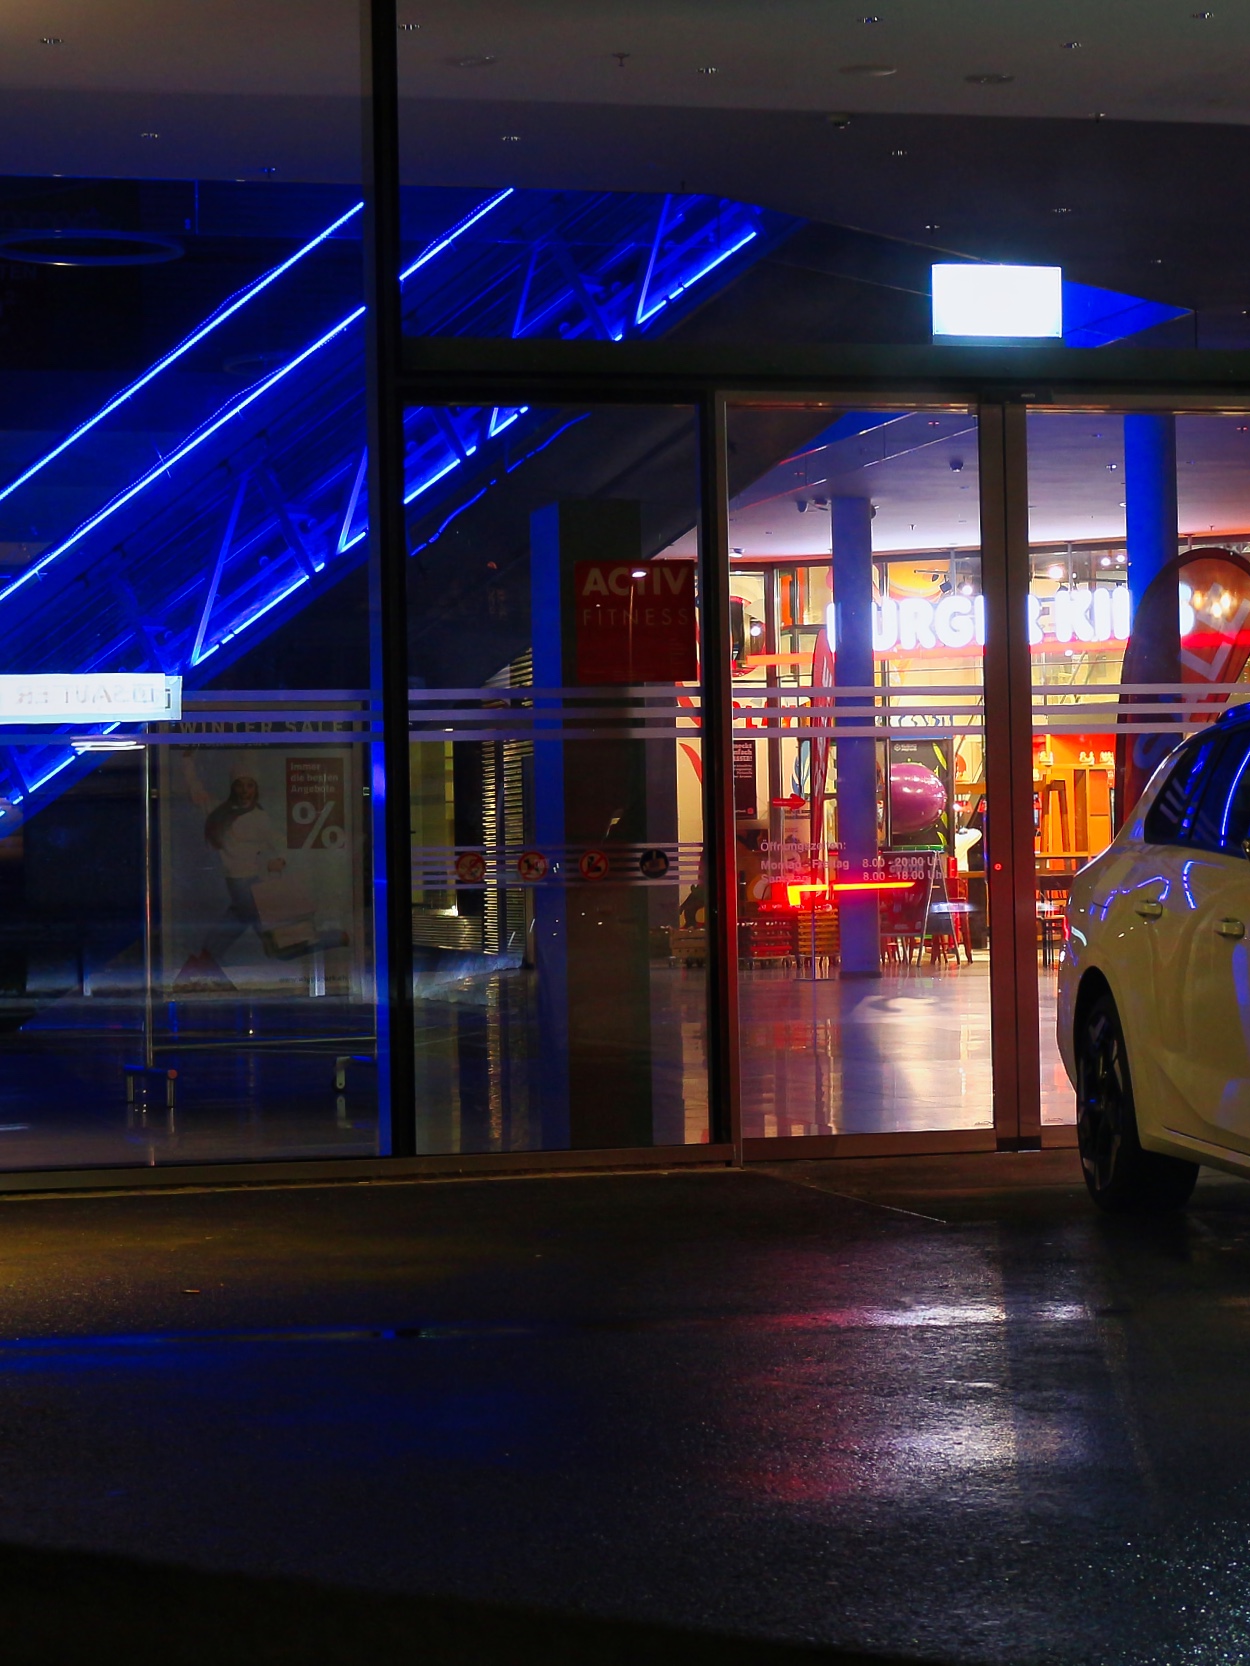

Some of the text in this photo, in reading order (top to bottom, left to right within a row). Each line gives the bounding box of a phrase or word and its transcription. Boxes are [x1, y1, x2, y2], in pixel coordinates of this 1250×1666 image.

[582, 566, 689, 597] ACTIV
[583, 607, 689, 627] FITNESS
[290, 762, 321, 771] Immer
[290, 774, 304, 782] die
[290, 784, 336, 795] Angebote
[760, 838, 846, 852] Öffnungszeen:
[812, 858, 850, 871] Fretag
[862, 858, 885, 868] 8.00
[863, 871, 886, 881] 8.00
